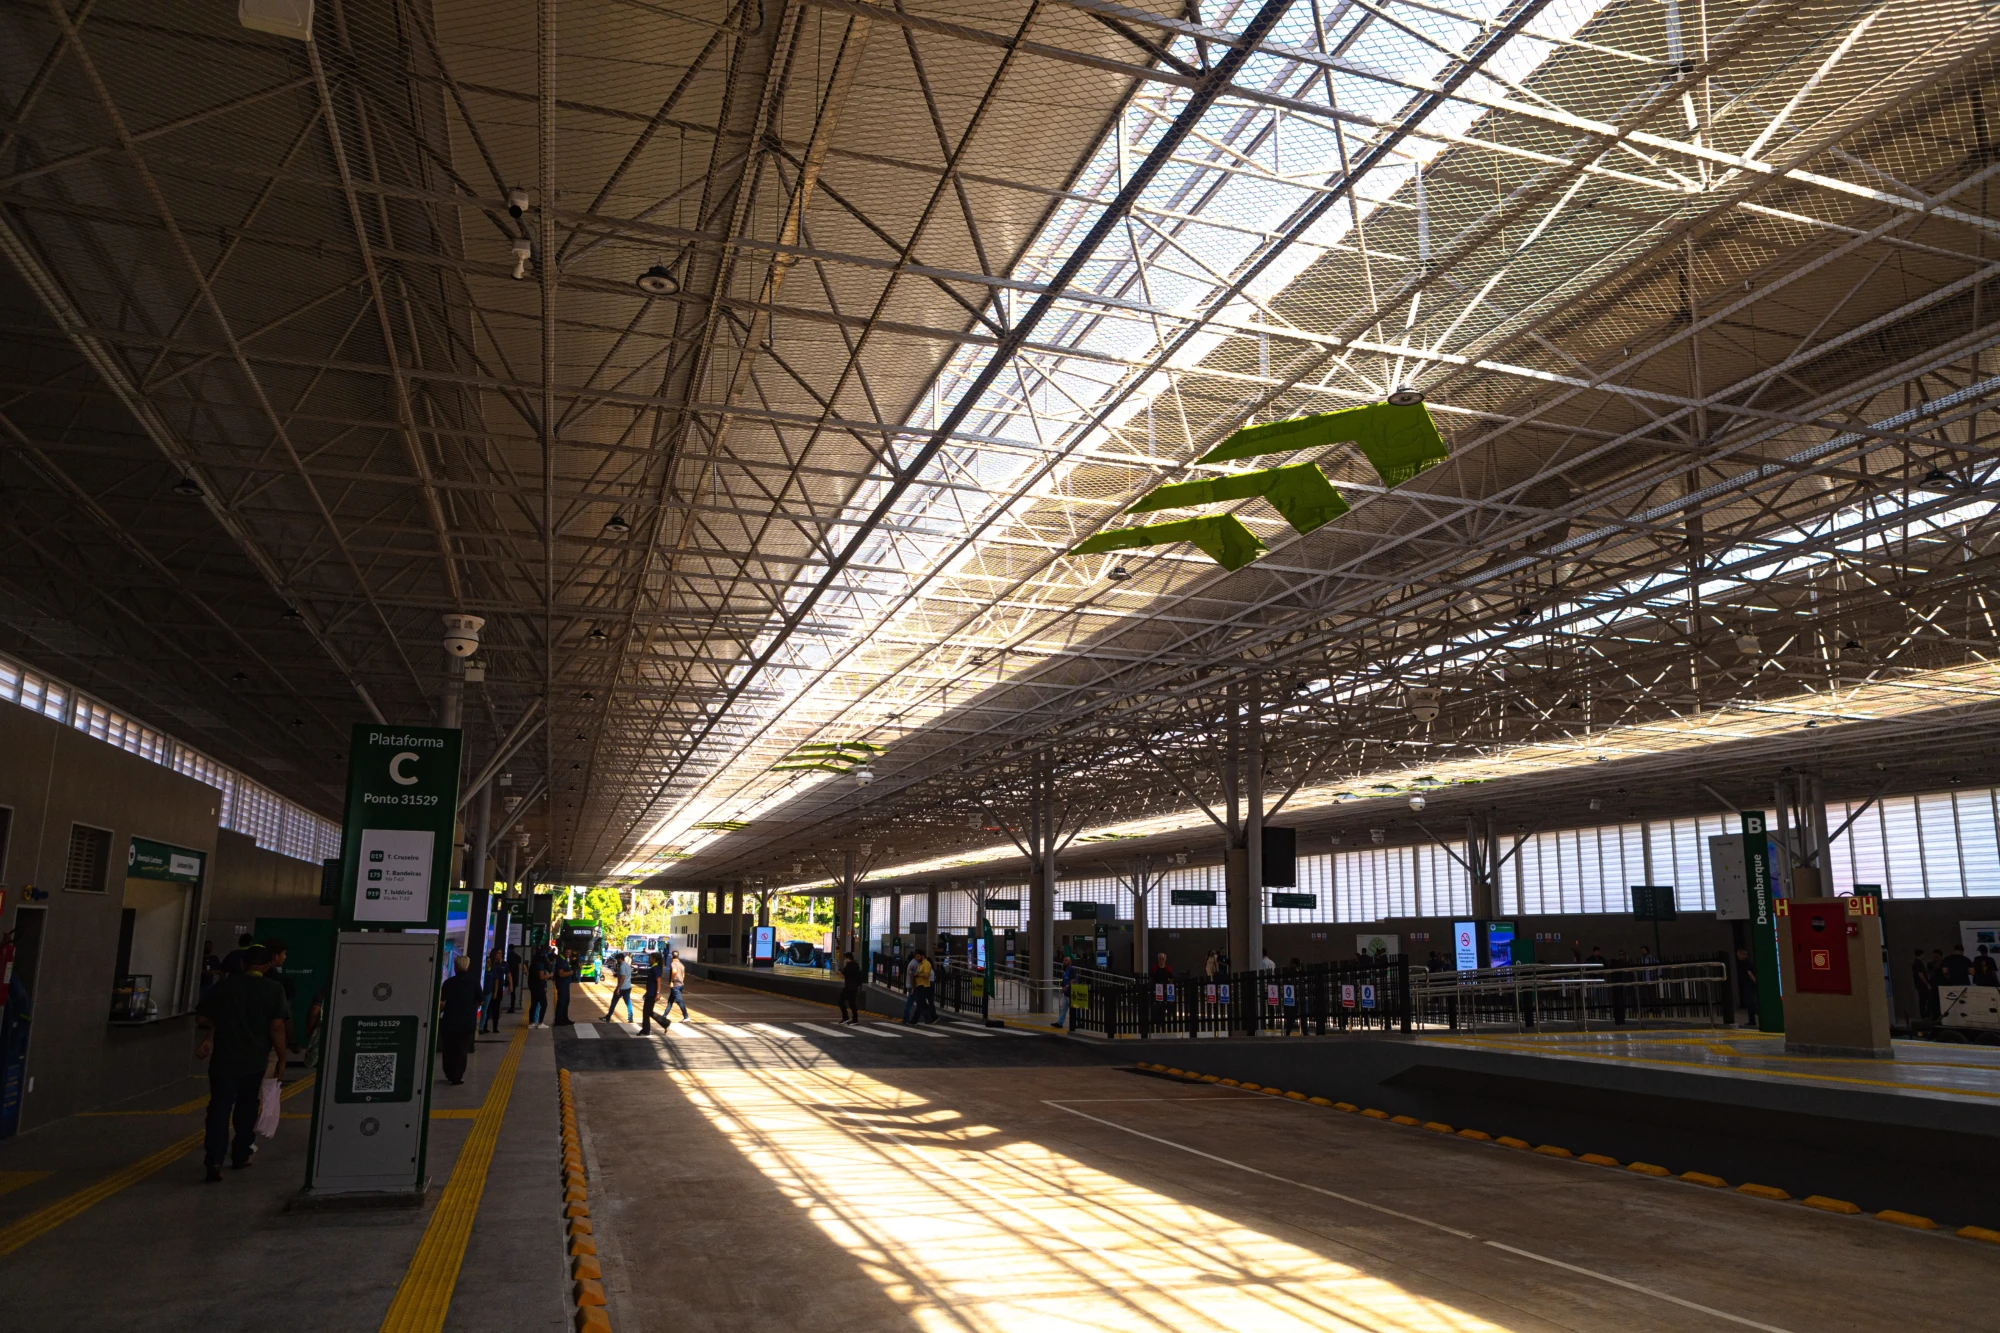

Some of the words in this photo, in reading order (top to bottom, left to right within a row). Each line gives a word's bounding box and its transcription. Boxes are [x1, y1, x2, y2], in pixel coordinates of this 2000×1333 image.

[369, 732, 444, 748] Plataforma
[389, 752, 420, 786] C
[364, 793, 399, 804] Ponto
[401, 794, 438, 806] 31529
[1748, 817, 1762, 834] B
[1754, 854, 1768, 925] Desembarque
[511, 904, 519, 913] C
[1776, 900, 1788, 916] H
[1862, 897, 1874, 915] H
